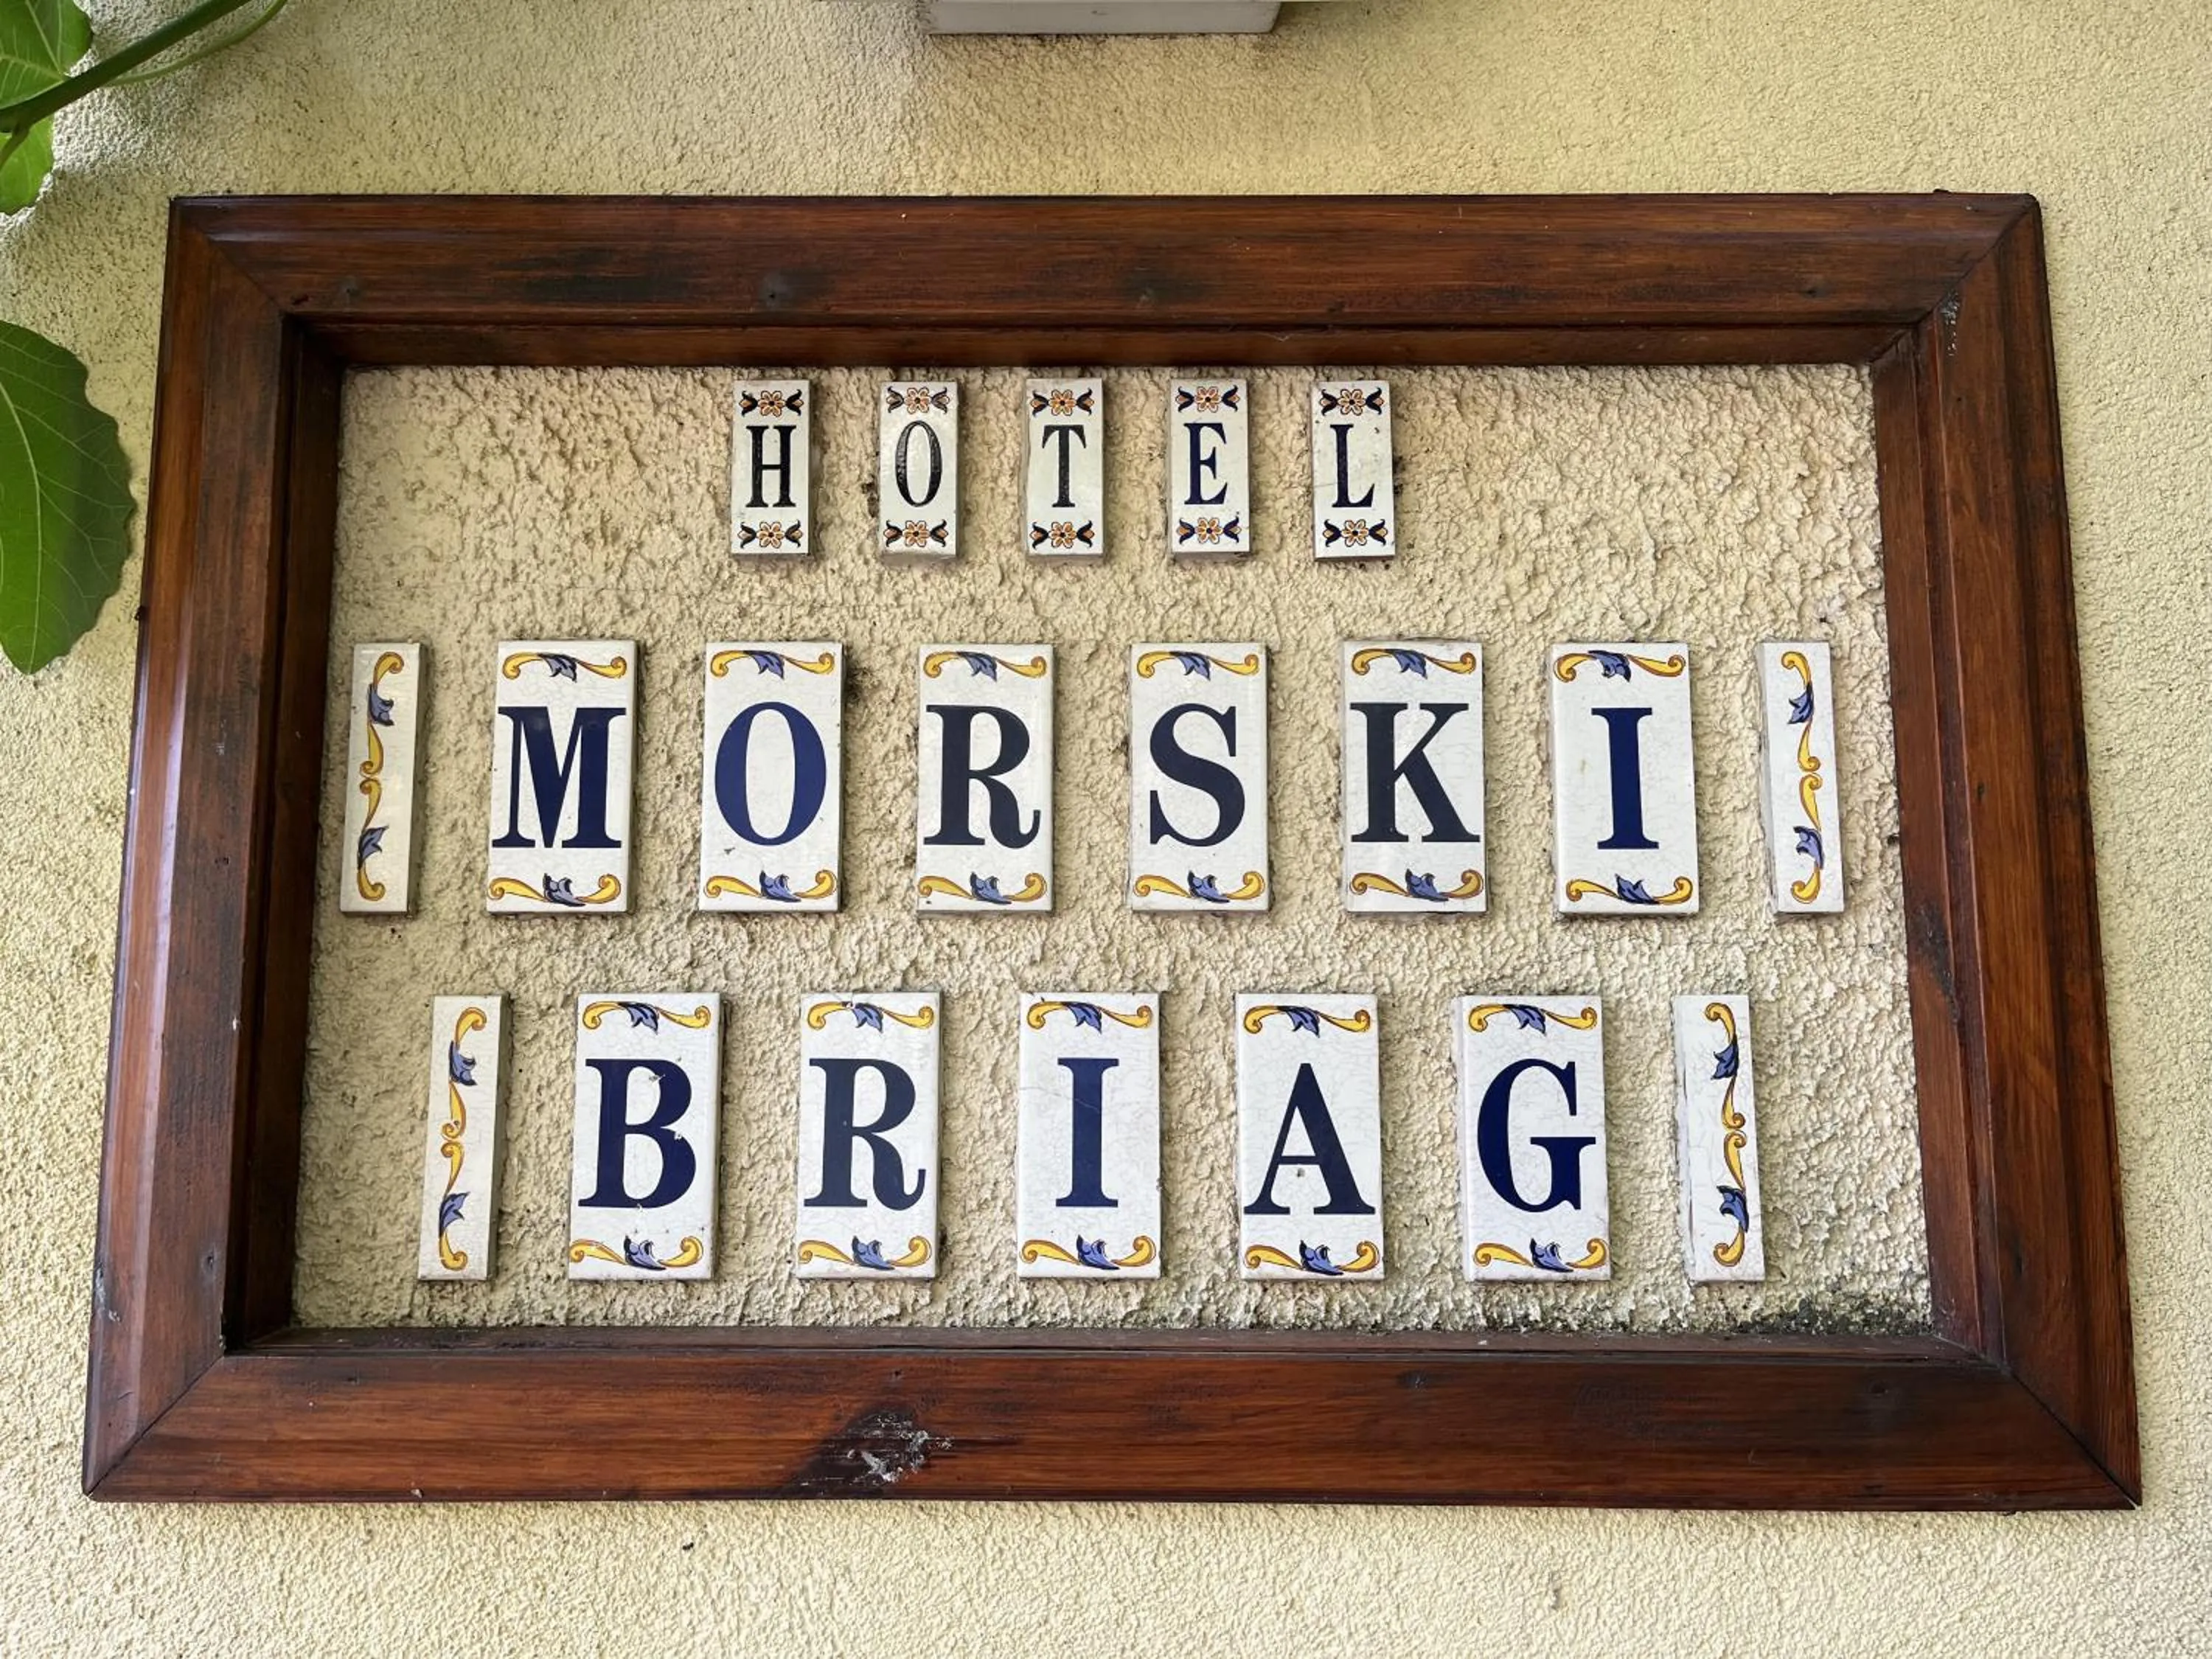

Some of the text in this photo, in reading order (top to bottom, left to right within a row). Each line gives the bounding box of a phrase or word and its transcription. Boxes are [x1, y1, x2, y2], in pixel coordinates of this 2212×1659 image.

[745, 420, 1376, 509] HOTEL
[491, 701, 1660, 851] MORSKI
[577, 1057, 1597, 1215] BRIAG
